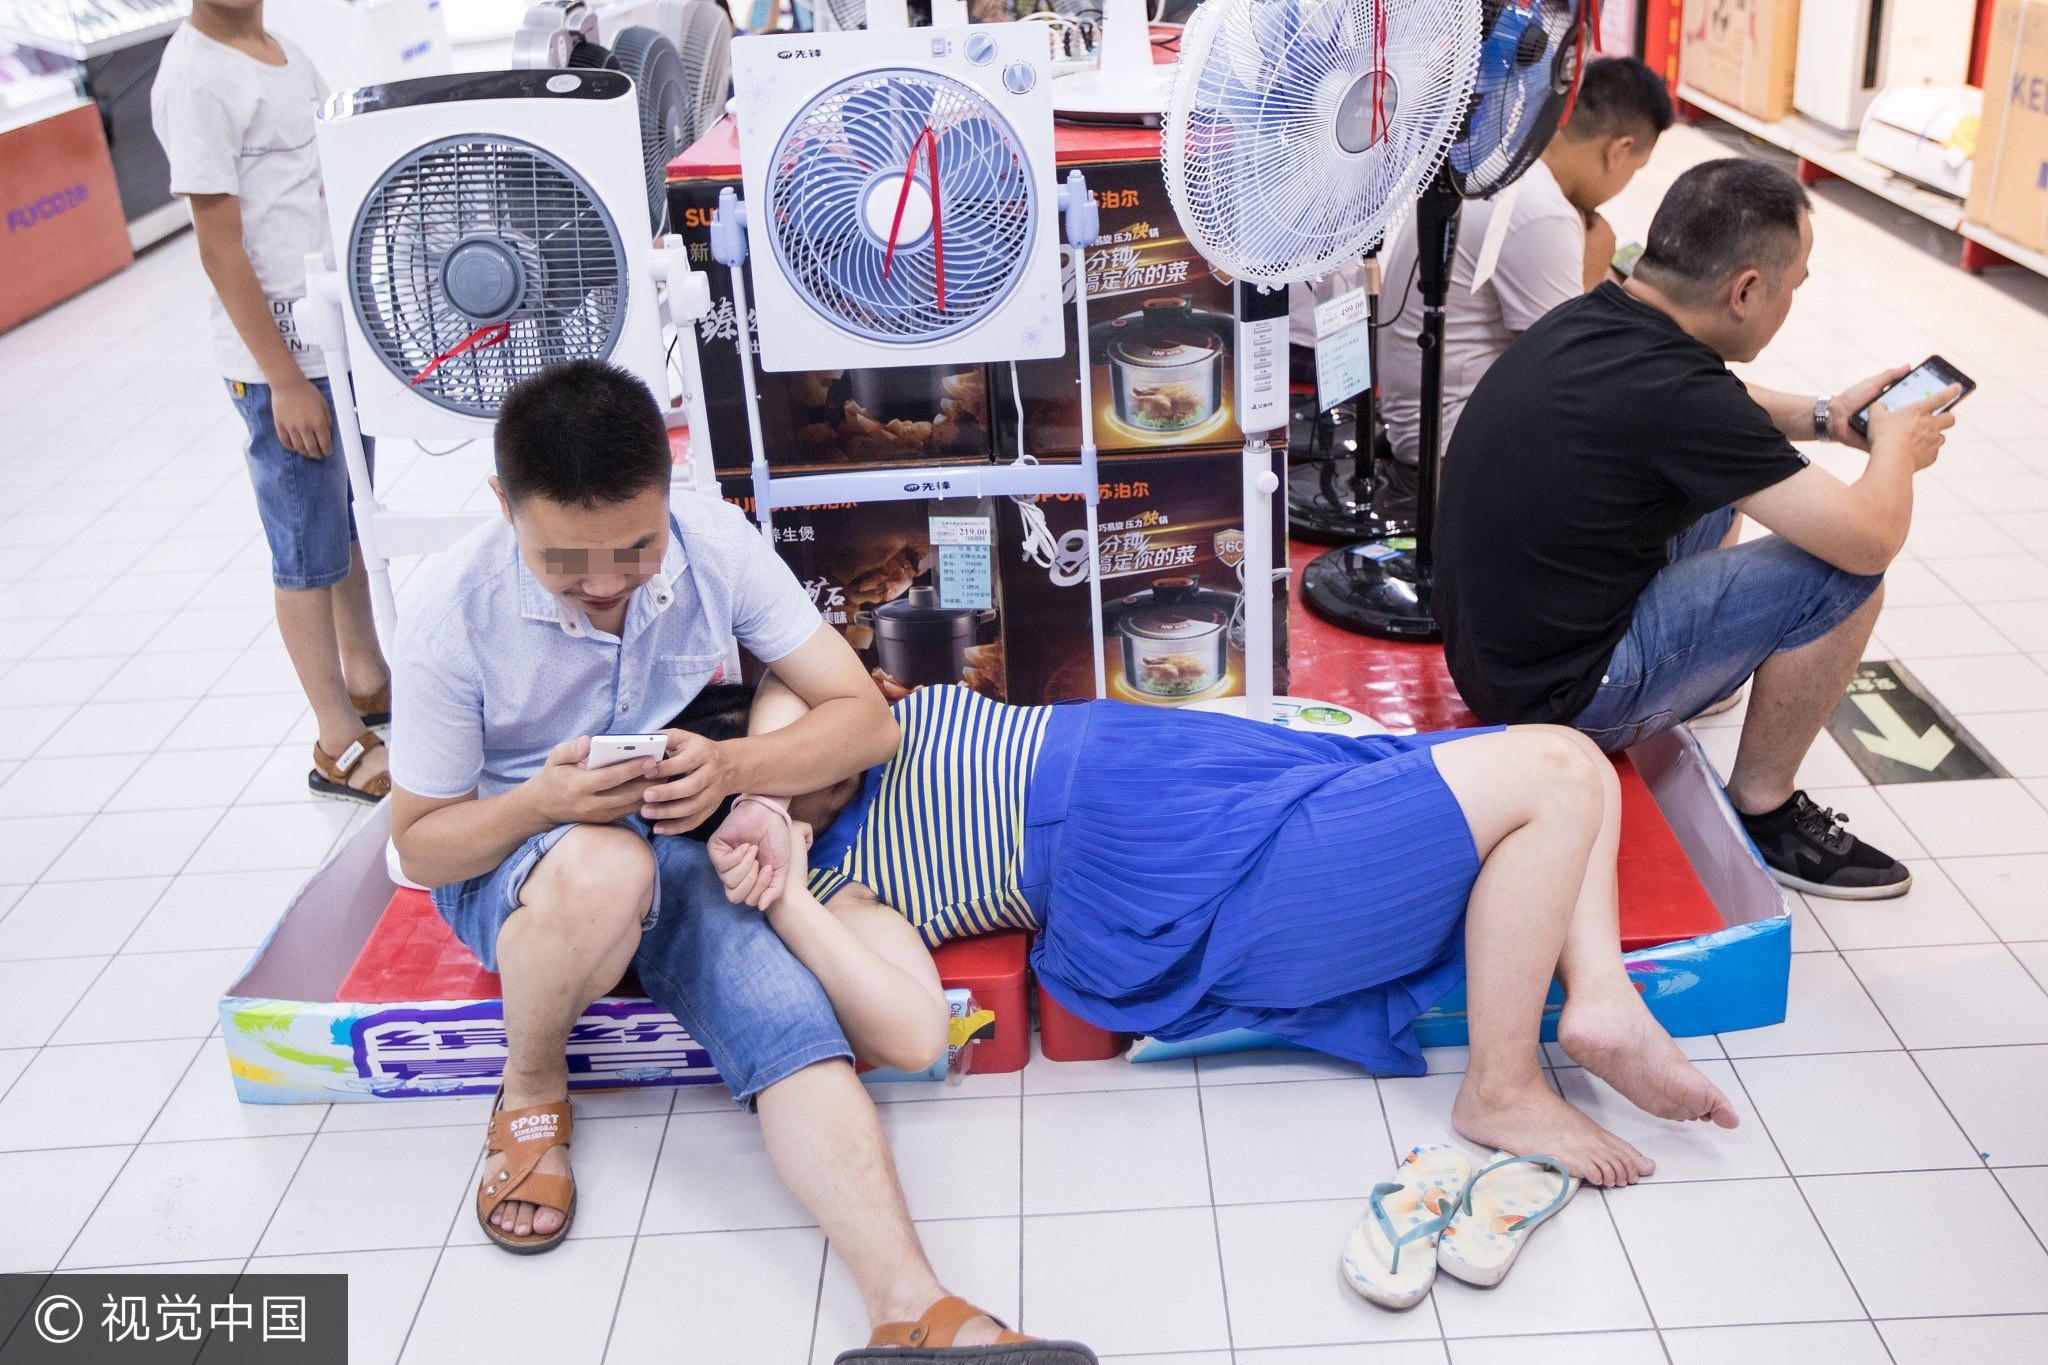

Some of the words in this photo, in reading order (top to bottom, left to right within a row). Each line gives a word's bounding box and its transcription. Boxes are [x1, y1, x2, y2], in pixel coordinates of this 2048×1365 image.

[794, 48, 822, 60] 先锋
[922, 480, 951, 492] 先锋
[959, 528, 988, 536] 219.00
[510, 1113, 560, 1132] SPORT
